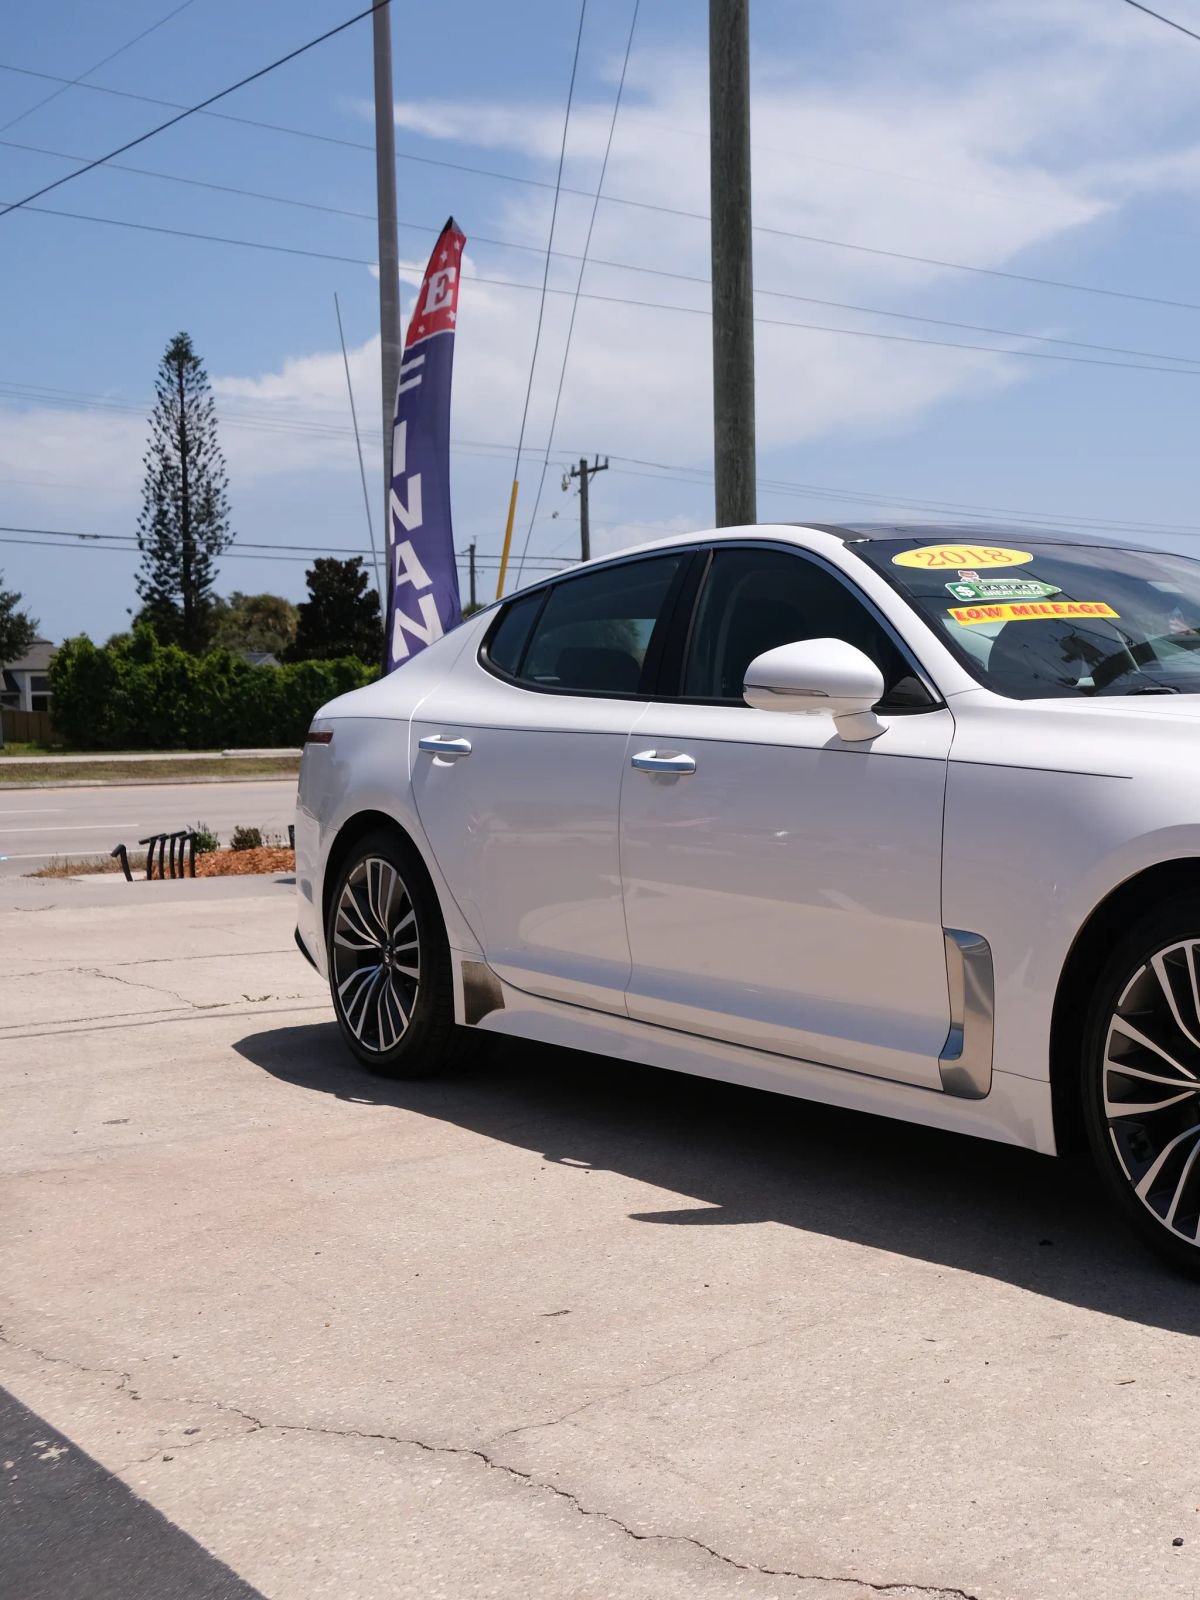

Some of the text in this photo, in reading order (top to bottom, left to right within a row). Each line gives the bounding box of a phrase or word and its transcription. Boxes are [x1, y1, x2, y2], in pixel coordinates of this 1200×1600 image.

[914, 549, 1013, 567] 2018
[953, 604, 1110, 621] LOW MILEAGE
